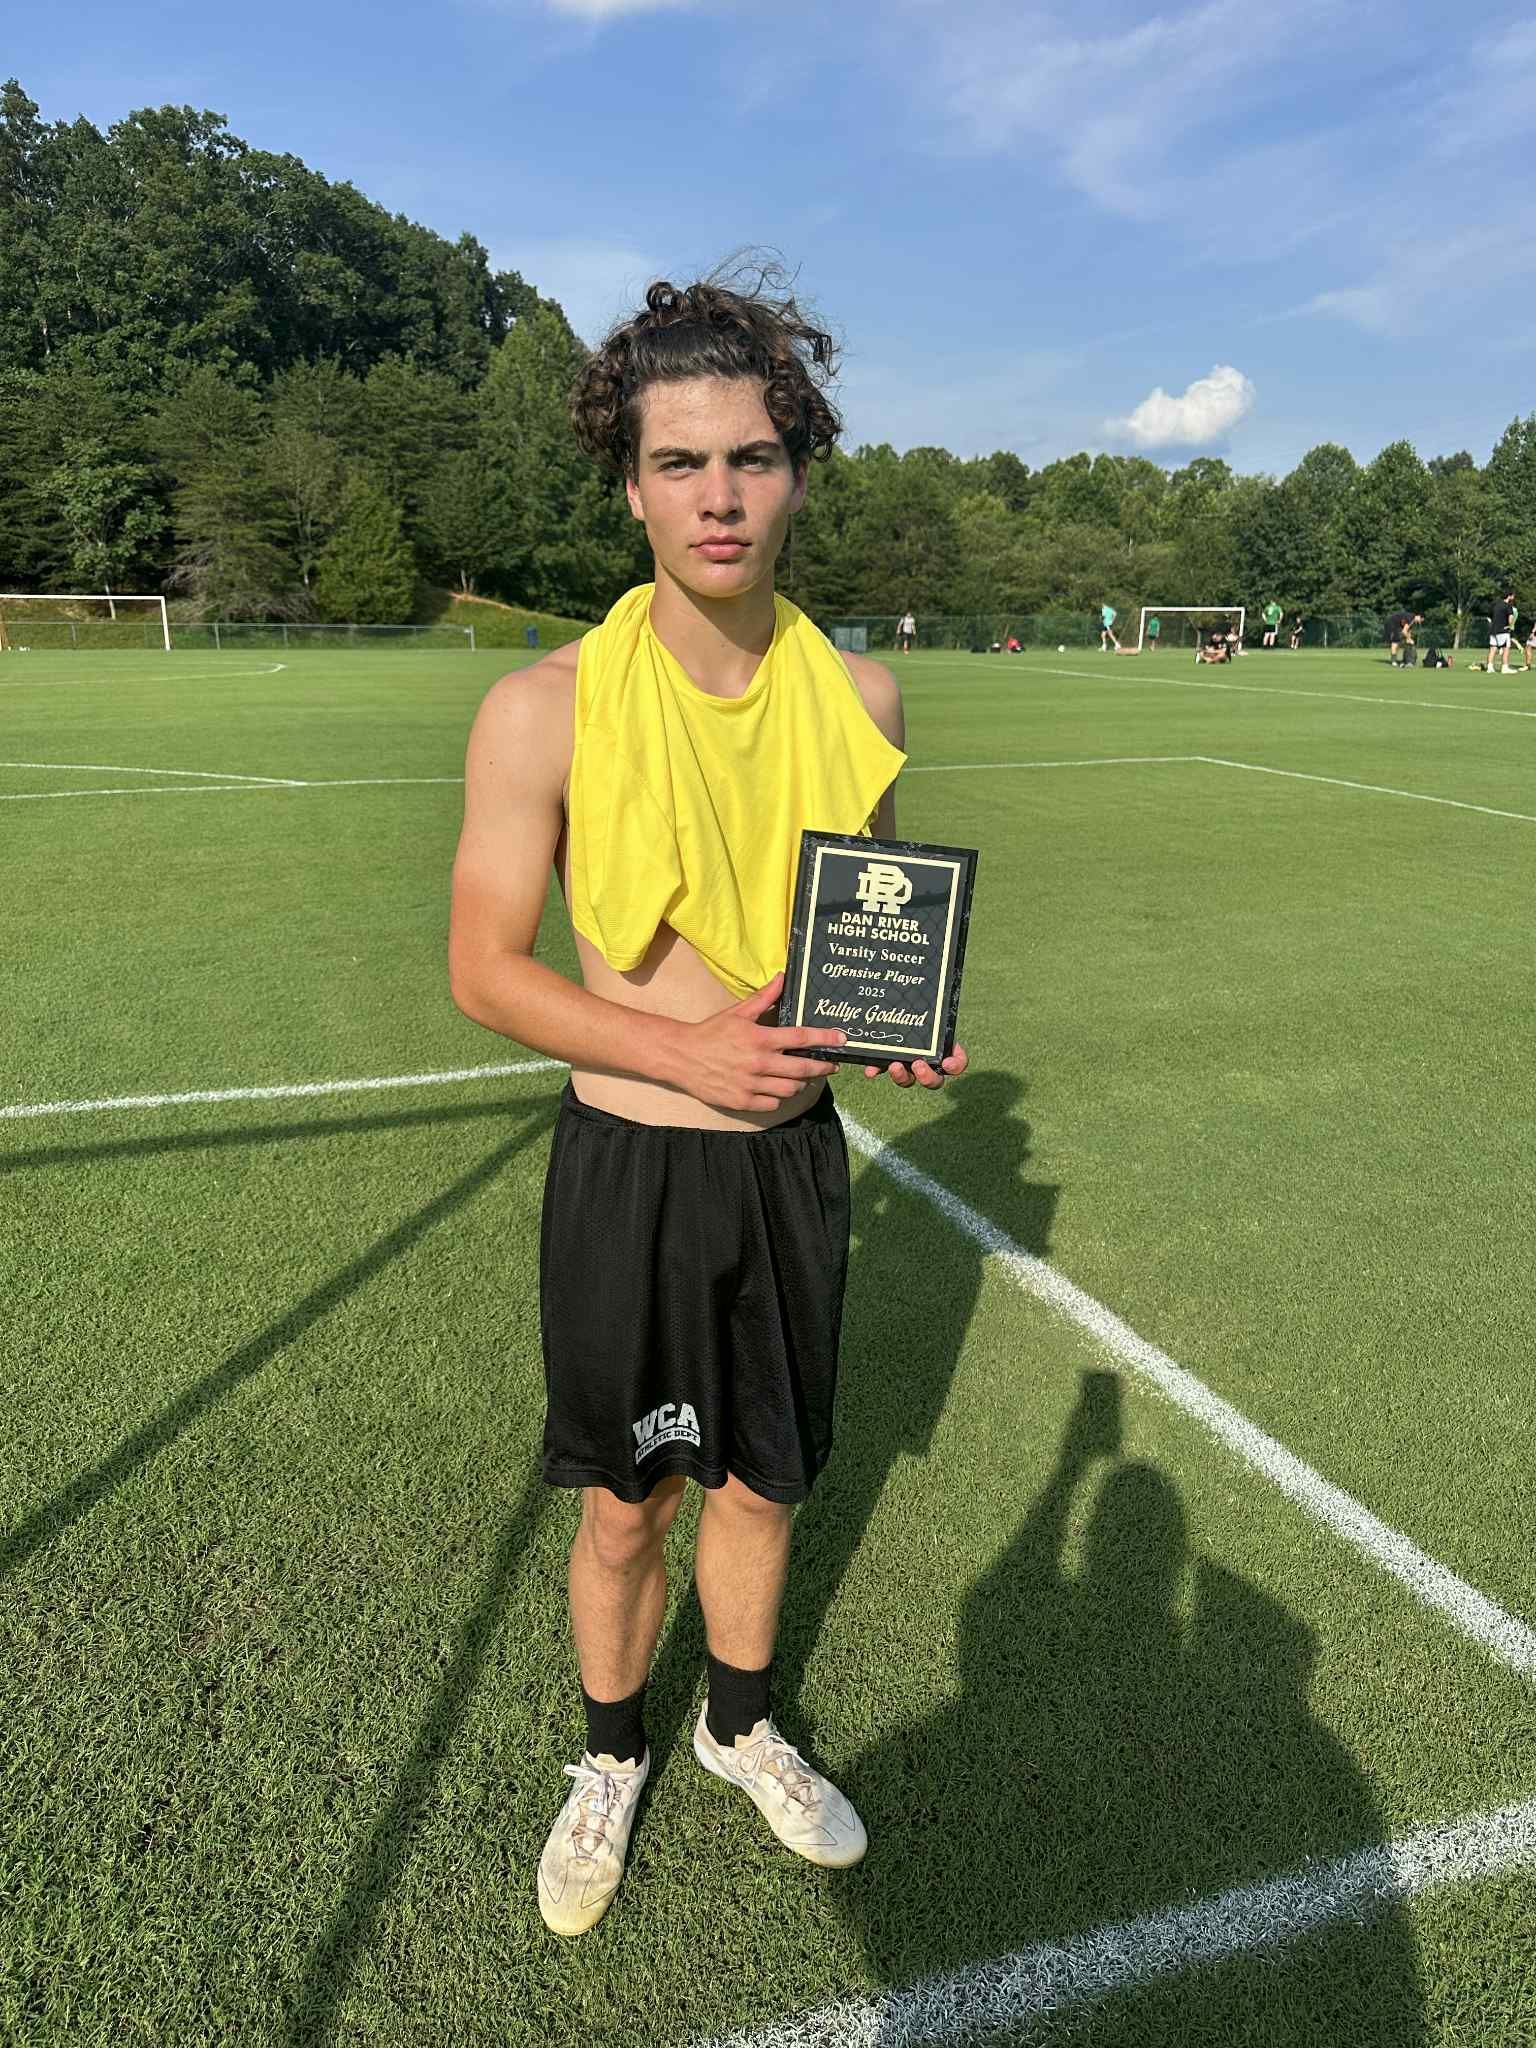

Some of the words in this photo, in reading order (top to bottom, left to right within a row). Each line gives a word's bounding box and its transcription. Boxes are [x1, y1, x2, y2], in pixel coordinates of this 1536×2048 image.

[841, 911, 873, 926] DAN
[877, 916, 919, 931] RIVER
[827, 923, 866, 938] HIGH
[870, 927, 930, 945] SCHOOL
[828, 942, 877, 961] Varsity
[881, 949, 925, 965] Soccer
[822, 962, 881, 980] Offensive
[884, 971, 925, 986] Player
[858, 986, 886, 998] 2025
[814, 998, 860, 1022] Rallye
[865, 1004, 928, 1027] Goddard
[632, 1402, 700, 1446] WCA
[674, 1429, 698, 1441] DEPT
